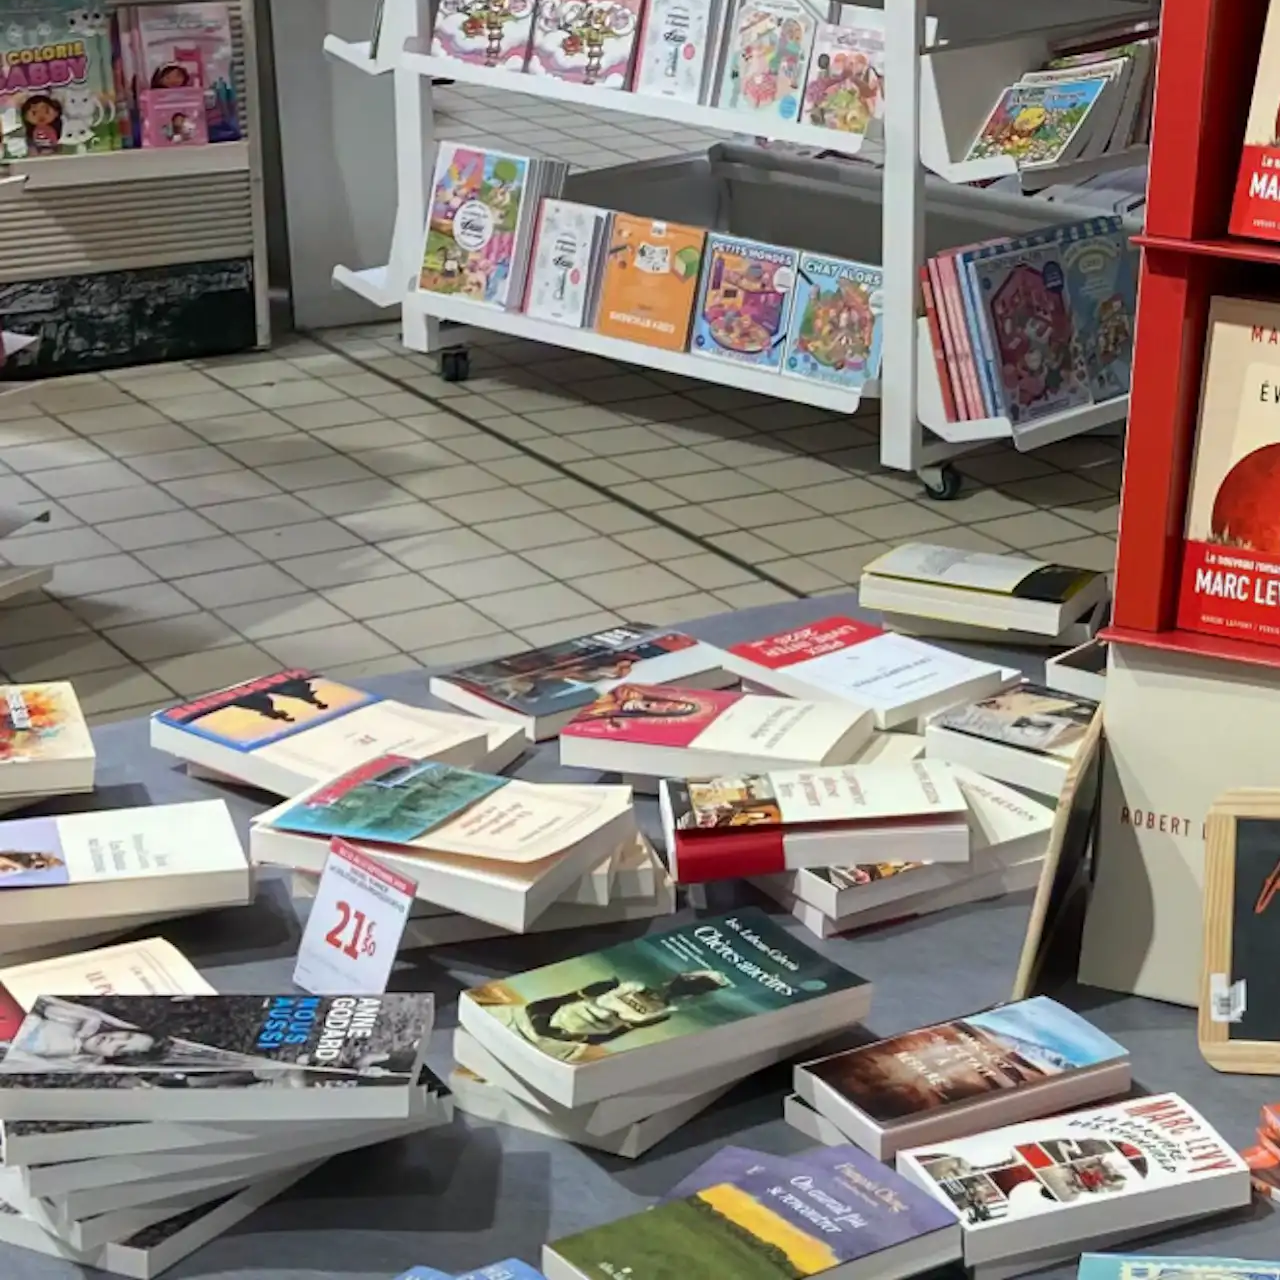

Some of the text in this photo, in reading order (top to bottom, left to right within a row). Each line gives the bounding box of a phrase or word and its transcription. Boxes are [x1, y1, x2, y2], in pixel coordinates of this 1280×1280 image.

[1195, 567, 1249, 602] MARC
[1119, 805, 1192, 837] ROBERT
[325, 900, 365, 961] 21
[256, 997, 291, 1049] AUSSI
[315, 997, 357, 1060] GODARD
[346, 997, 382, 1040] ANNE
[1124, 1099, 1237, 1174] MARC LEVY
